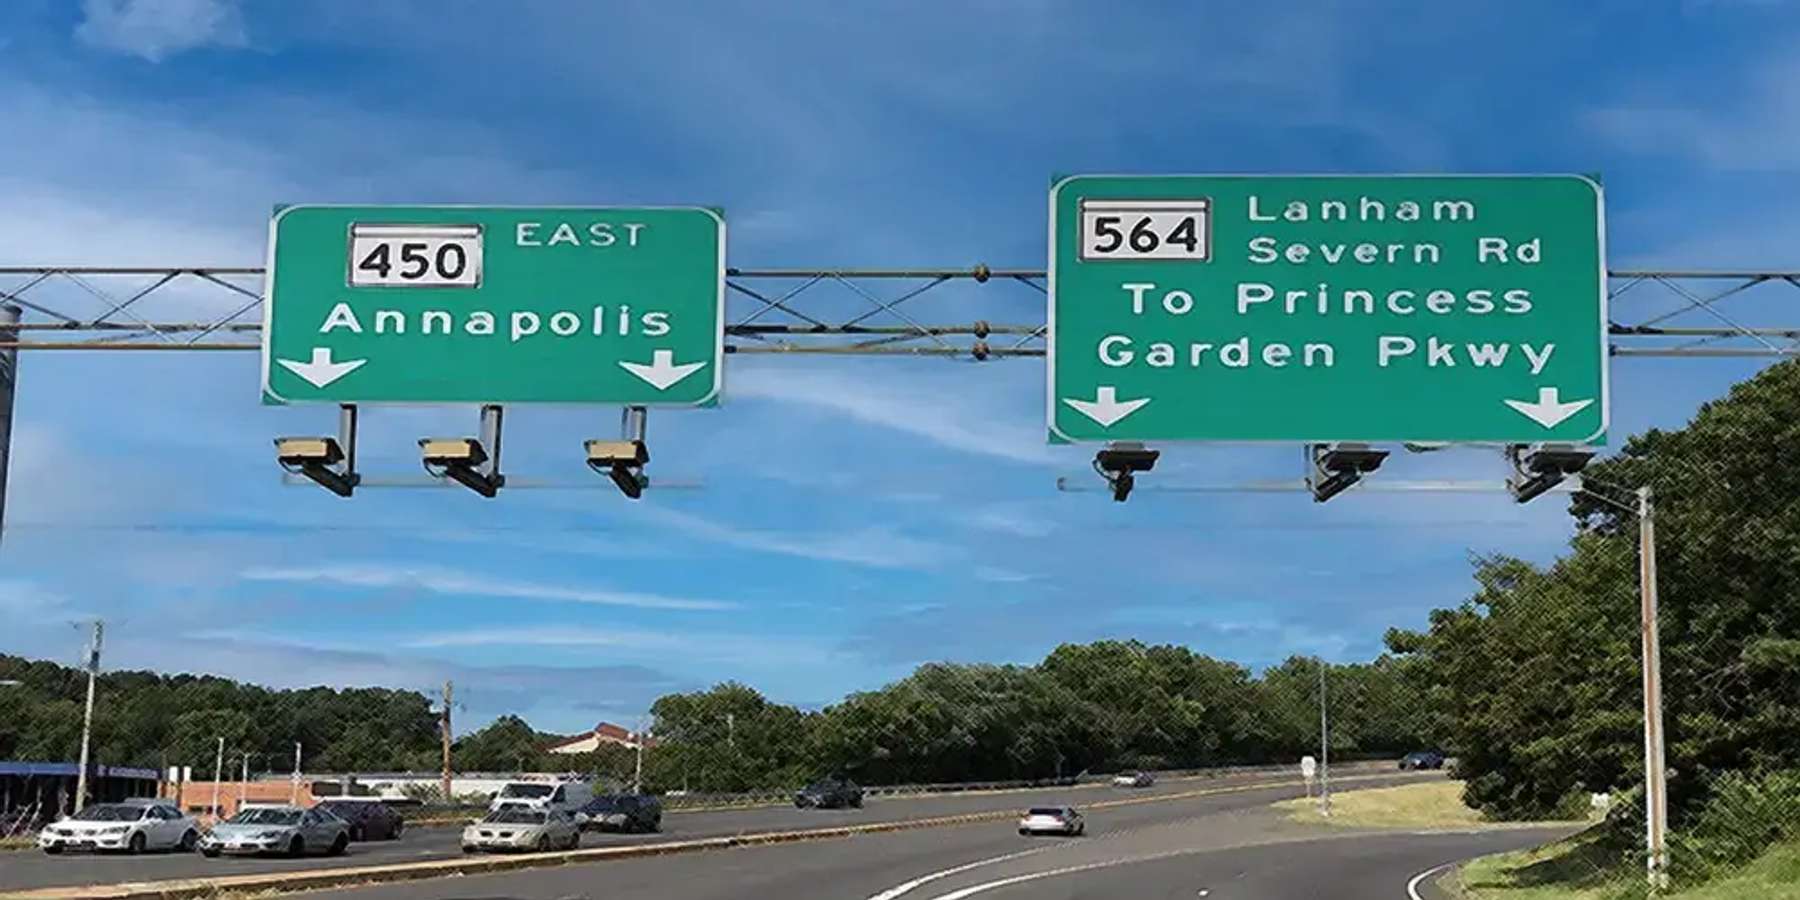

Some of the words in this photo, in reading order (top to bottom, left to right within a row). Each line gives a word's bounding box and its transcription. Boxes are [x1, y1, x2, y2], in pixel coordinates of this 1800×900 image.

[1248, 195, 1476, 222] Lanham
[517, 223, 646, 246] EAST
[1092, 215, 1198, 254] 564
[1248, 237, 1439, 264] Severn
[1479, 237, 1542, 264] Rd
[358, 242, 468, 279] 450
[1122, 283, 1195, 315] To
[1237, 283, 1534, 315] Princess
[319, 302, 672, 342] Annapolis
[1097, 335, 1335, 368] Garden
[1378, 336, 1556, 375] Pkwy
